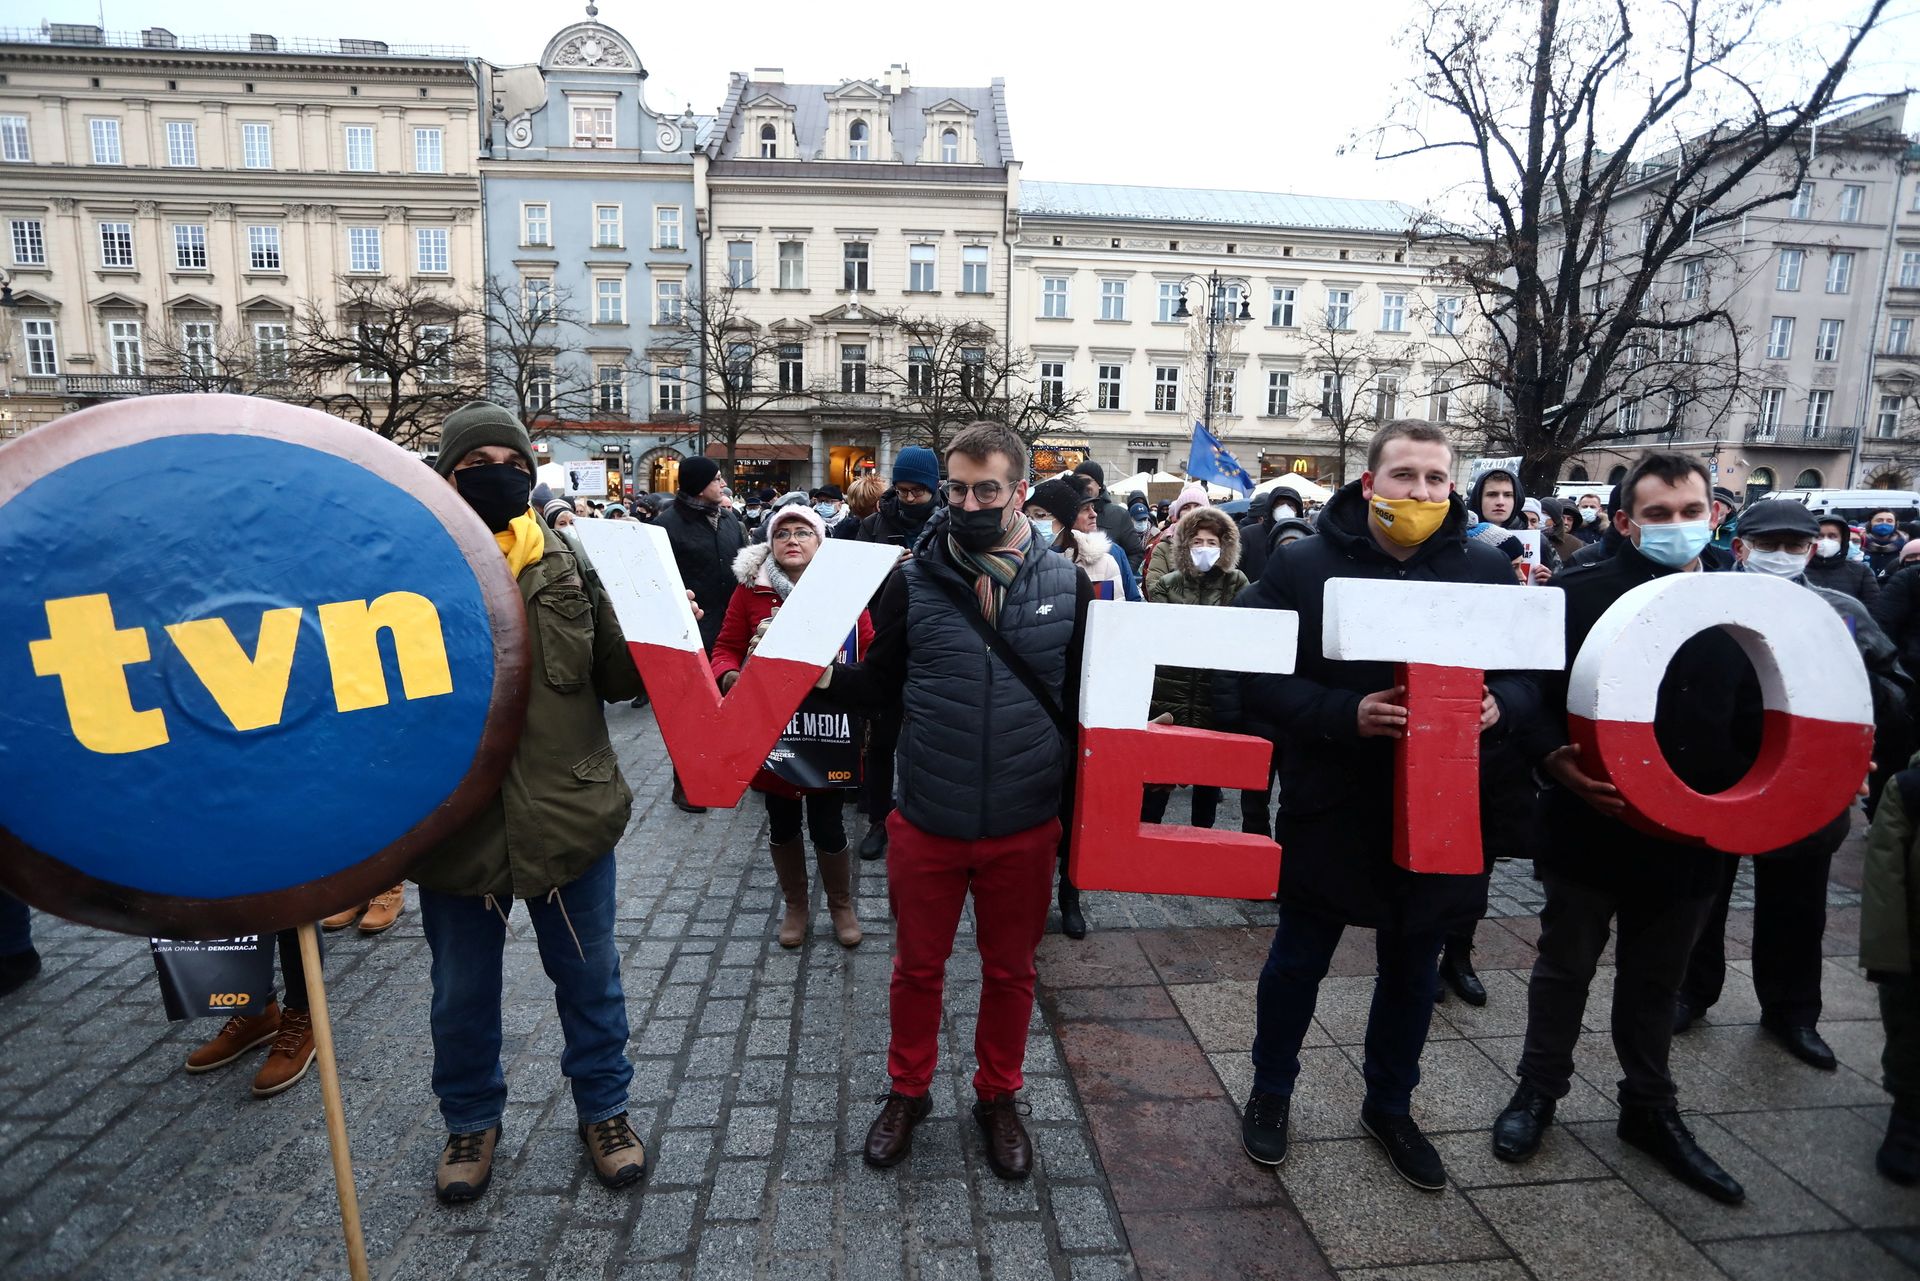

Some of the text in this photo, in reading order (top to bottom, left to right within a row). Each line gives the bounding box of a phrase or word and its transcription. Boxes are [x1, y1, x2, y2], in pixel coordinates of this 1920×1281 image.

[1128, 440, 1171, 448] EXCHAGE
[1375, 507, 1395, 522] 2050
[28, 590, 454, 754] tvn
[803, 712, 851, 738] MEDIA
[828, 771, 851, 780] KOD
[207, 944, 258, 952] DEMOKRACJA
[209, 993, 251, 1006] KOD
